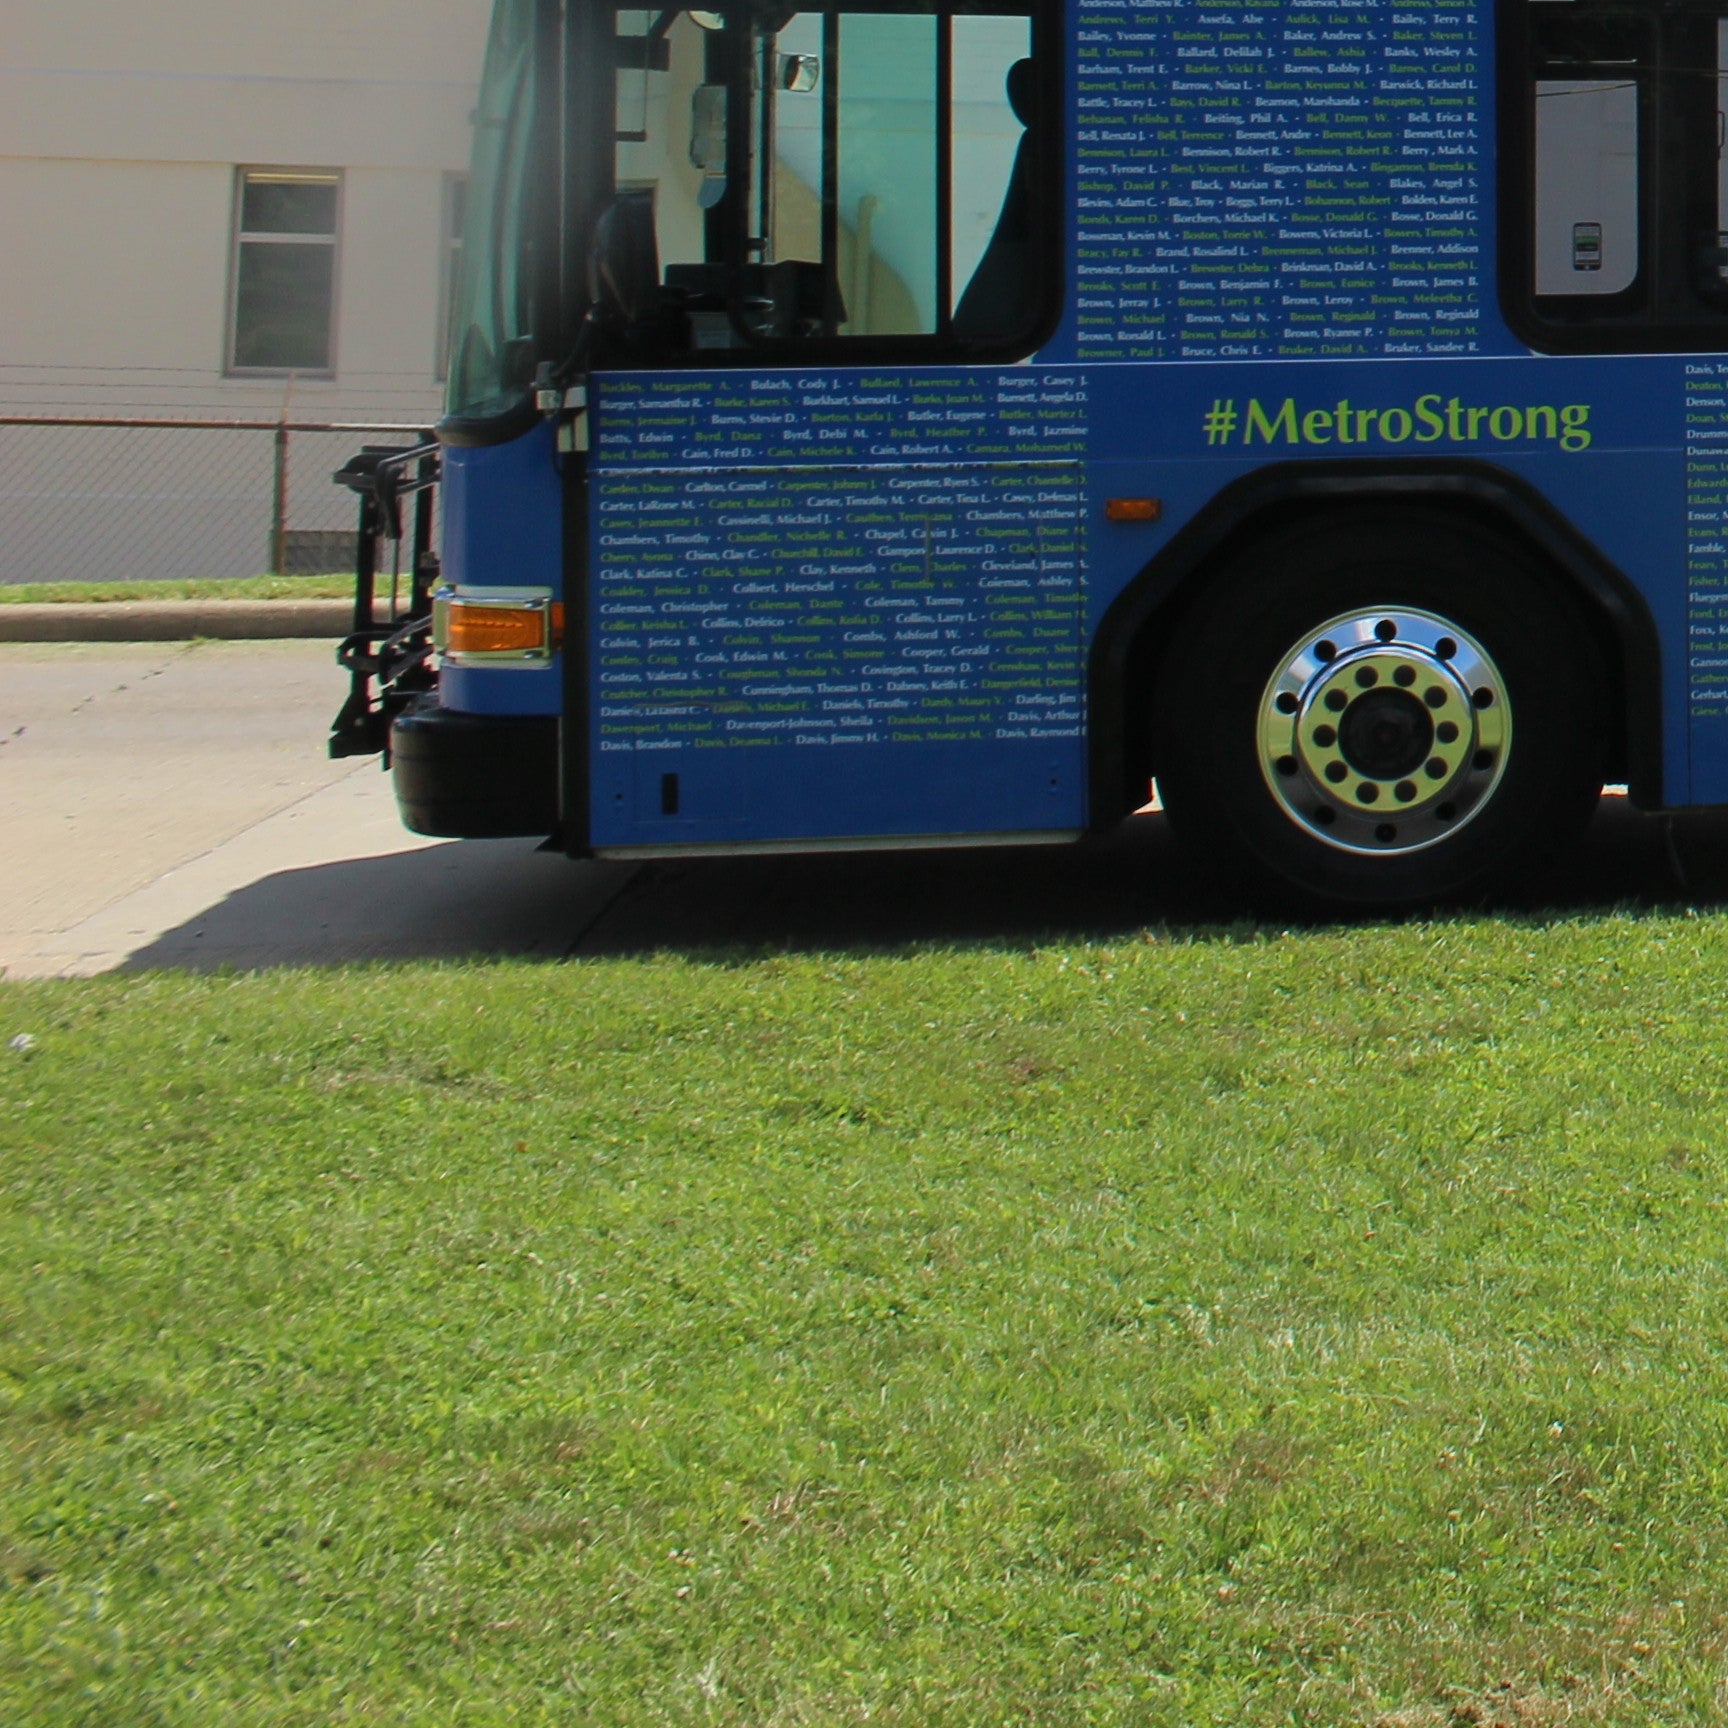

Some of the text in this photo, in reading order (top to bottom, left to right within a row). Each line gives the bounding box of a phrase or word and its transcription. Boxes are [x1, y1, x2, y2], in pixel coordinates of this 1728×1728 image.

[1393, 14, 1426, 24] Bailey,
[1434, 14, 1459, 24] Terry
[1284, 30, 1316, 40] Baker,
[1322, 30, 1361, 40] Andrew
[1178, 47, 1218, 57] Ballard,
[1224, 47, 1262, 57] Delilah
[1385, 47, 1418, 57] Banks,
[1424, 47, 1460, 57] Wesley
[1284, 64, 1323, 74] Barnes,
[1328, 63, 1360, 74] Bobby
[1380, 80, 1424, 90] Barwick,
[1427, 79, 1466, 89] Richard
[1408, 112, 1430, 122] Bell,
[1437, 112, 1462, 122] Erica
[1191, 180, 1223, 190] Black,
[1230, 180, 1268, 189] Marian
[1390, 178, 1426, 188] Blakes,
[1433, 178, 1462, 190] Angel
[1437, 244, 1478, 253] Addison
[1283, 296, 1353, 305] Brown, Leroy
[999, 376, 1037, 388] Burger,
[1686, 397, 1726, 406] Denson,
[1204, 394, 1591, 451] #MetroStrong
[783, 430, 812, 440] Byrd,
[819, 429, 847, 439] Debi
[1009, 426, 1037, 436] Byrd,
[1044, 425, 1088, 436] Jazmine
[682, 449, 711, 459] Cain,
[714, 448, 739, 458] Fred
[870, 445, 899, 455] Cain,
[902, 444, 939, 454] Robert
[1688, 511, 1719, 520] Ensor,
[600, 601, 728, 614] Coleman, Christopher
[695, 652, 728, 663] Cook,
[733, 652, 768, 661] Edwin
